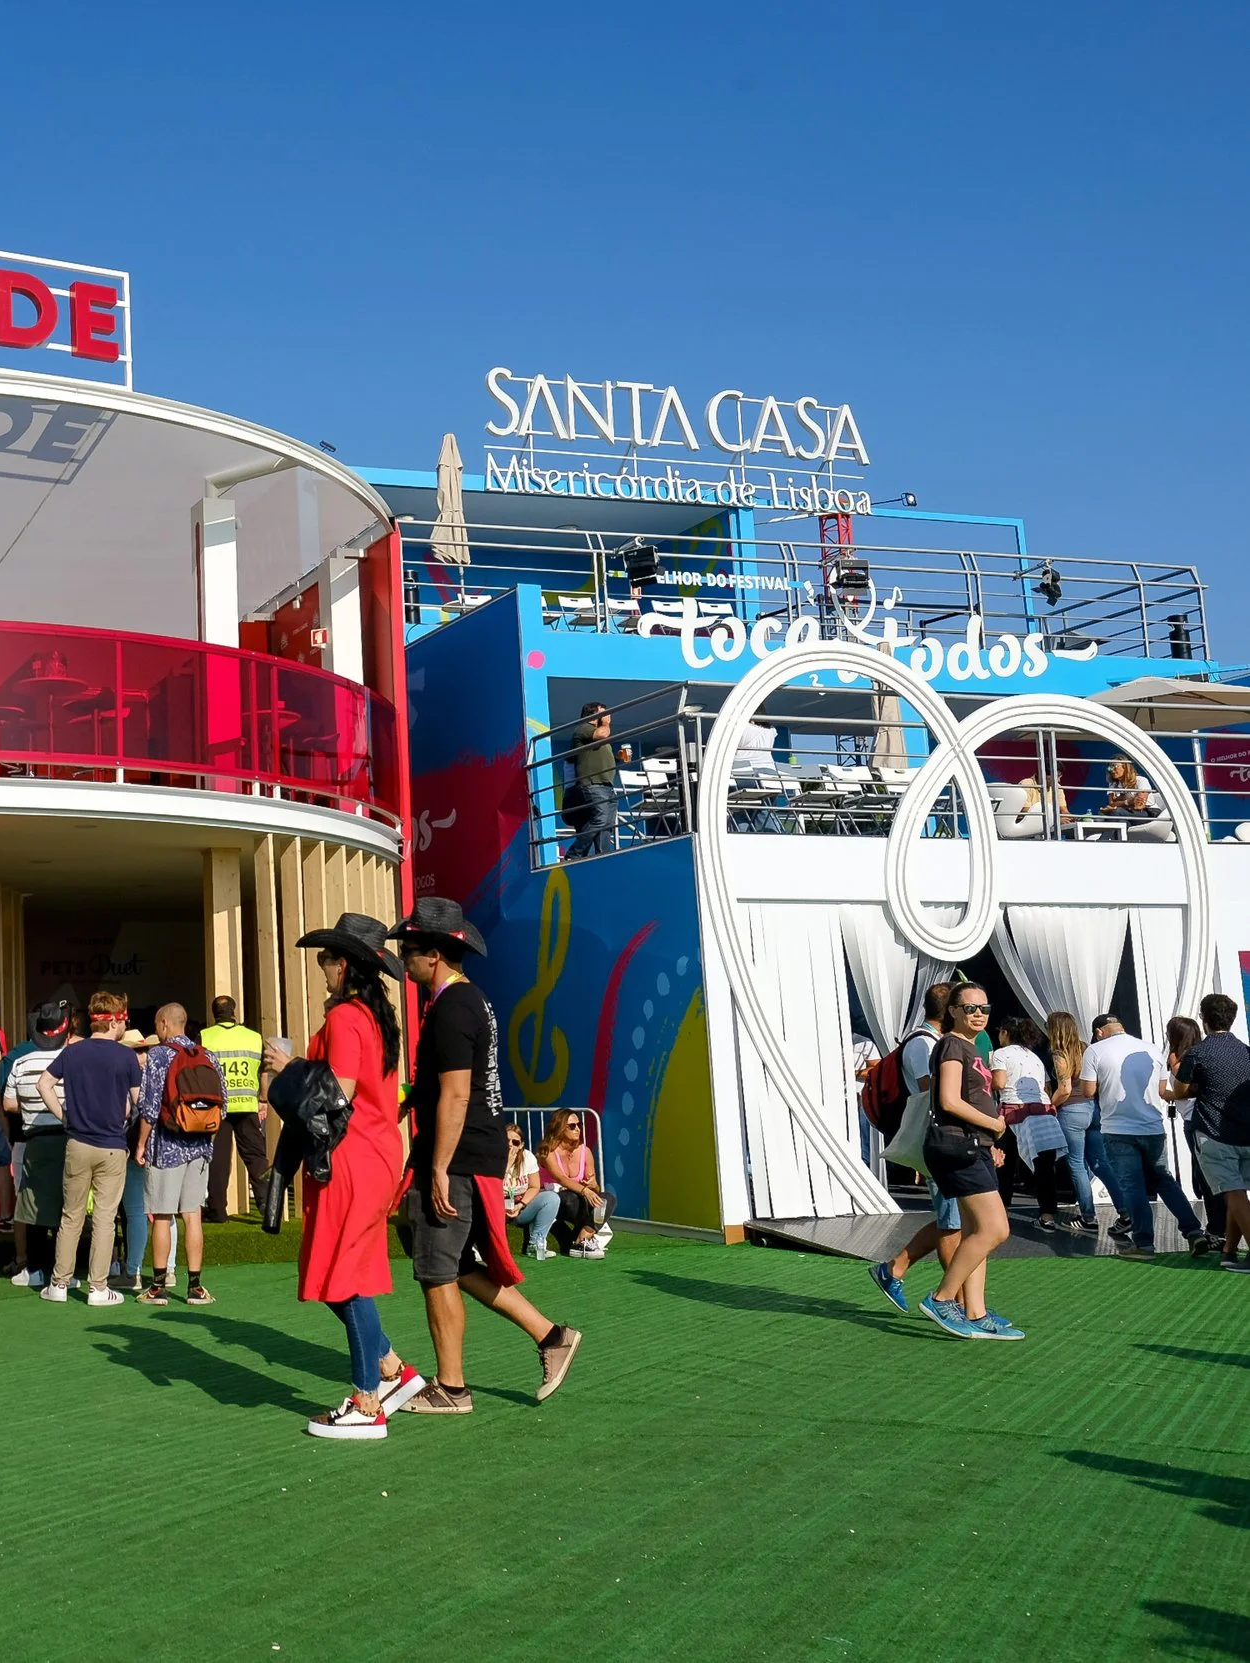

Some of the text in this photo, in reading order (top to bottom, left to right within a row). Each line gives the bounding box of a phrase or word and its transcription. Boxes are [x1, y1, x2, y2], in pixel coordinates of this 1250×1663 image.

[485, 367, 871, 467] SANTA CASA
[485, 452, 875, 516] Misericórdia de Lisboa
[657, 570, 793, 592] ELHOR DO FESTIVAL
[220, 1061, 249, 1077] 143
